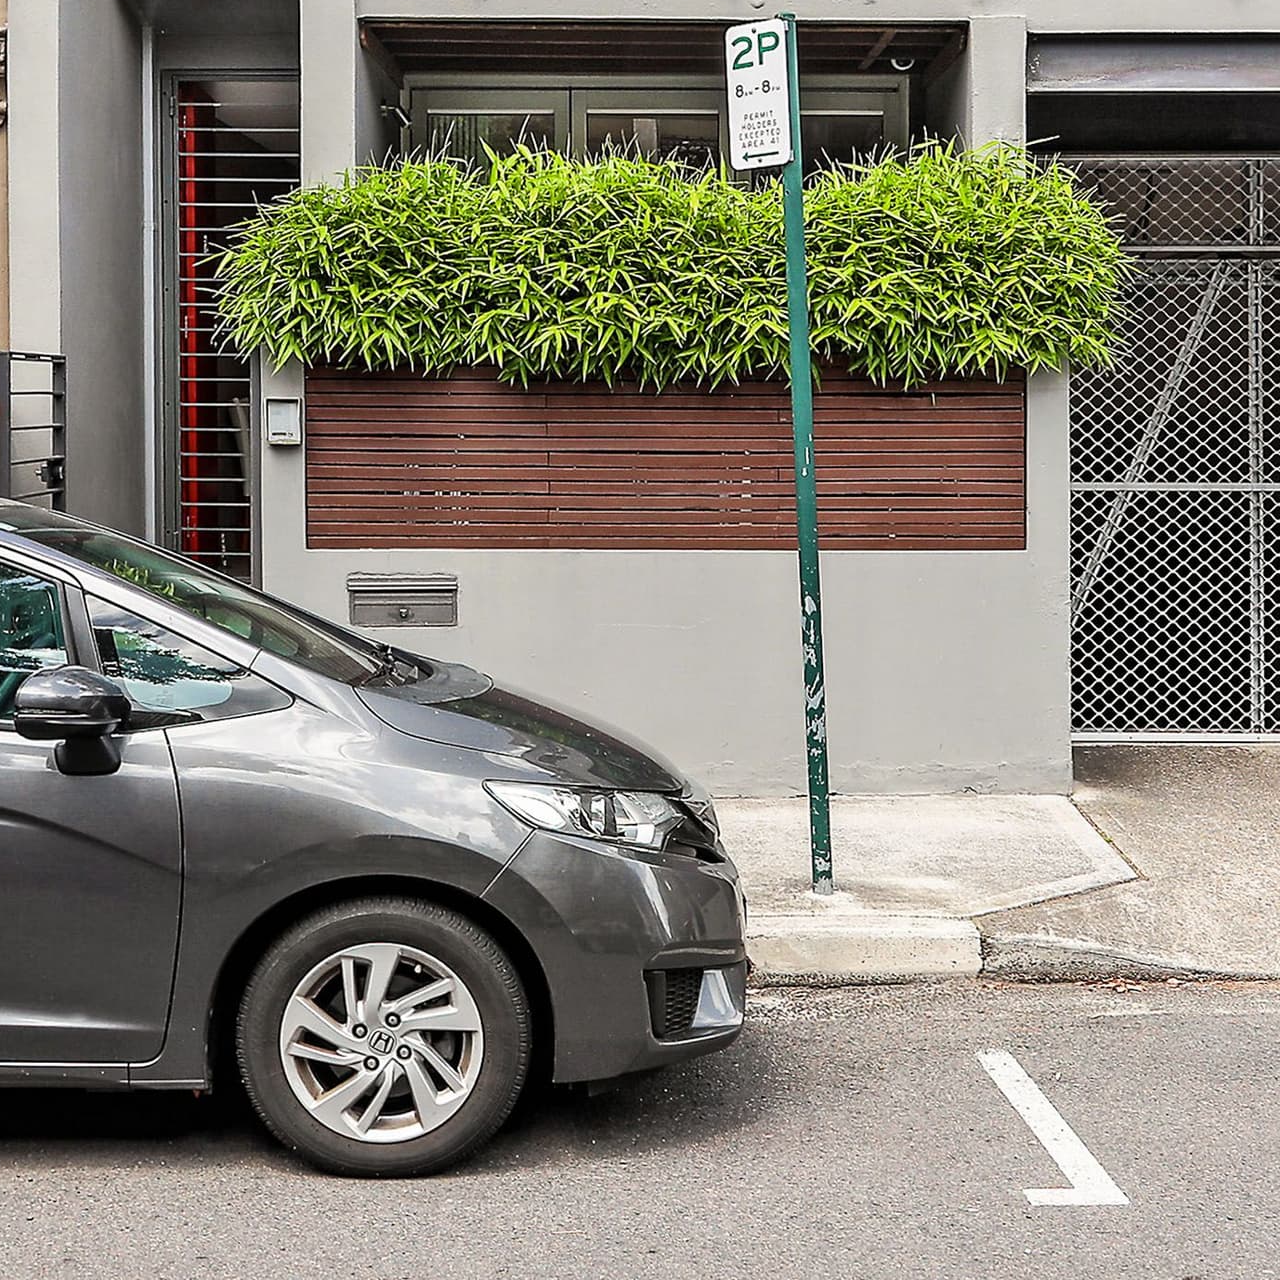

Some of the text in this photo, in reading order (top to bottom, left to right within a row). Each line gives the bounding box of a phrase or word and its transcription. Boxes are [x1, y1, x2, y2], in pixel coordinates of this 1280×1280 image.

[731, 31, 780, 70] 2P
[744, 110, 773, 120] PERMIT
[741, 119, 777, 130] HOLDERS
[738, 127, 781, 141] EXCEPTED
[742, 139, 765, 148] AREA
